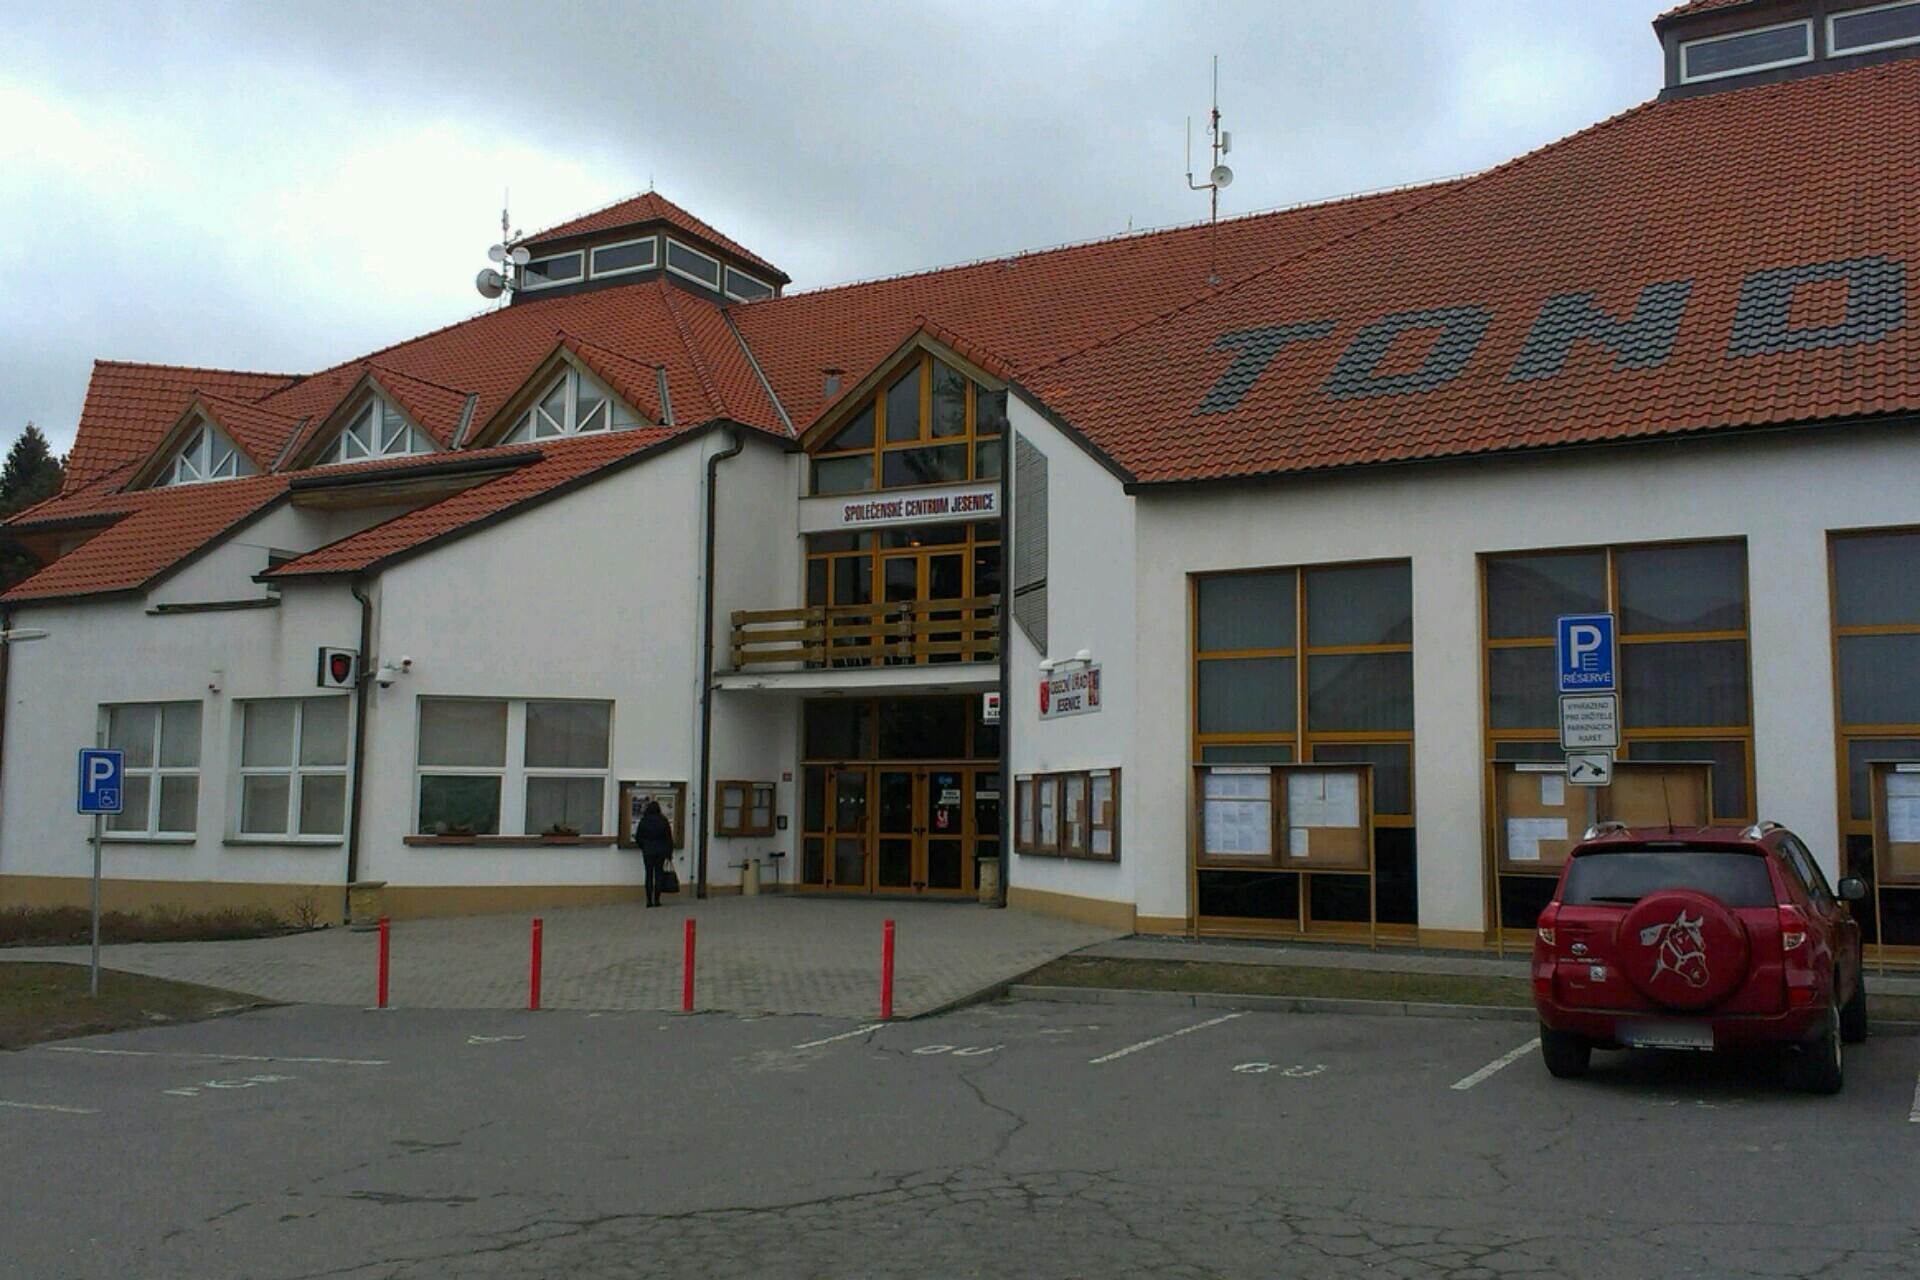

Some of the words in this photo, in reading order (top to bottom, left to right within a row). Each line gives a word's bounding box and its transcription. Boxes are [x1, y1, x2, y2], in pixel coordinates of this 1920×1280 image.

[844, 499, 903, 522] SPOLEČENSKÉ
[905, 497, 949, 514] CENTRUM
[951, 492, 994, 512] JESENICE
[1570, 625, 1602, 668] P
[89, 757, 114, 793] P
